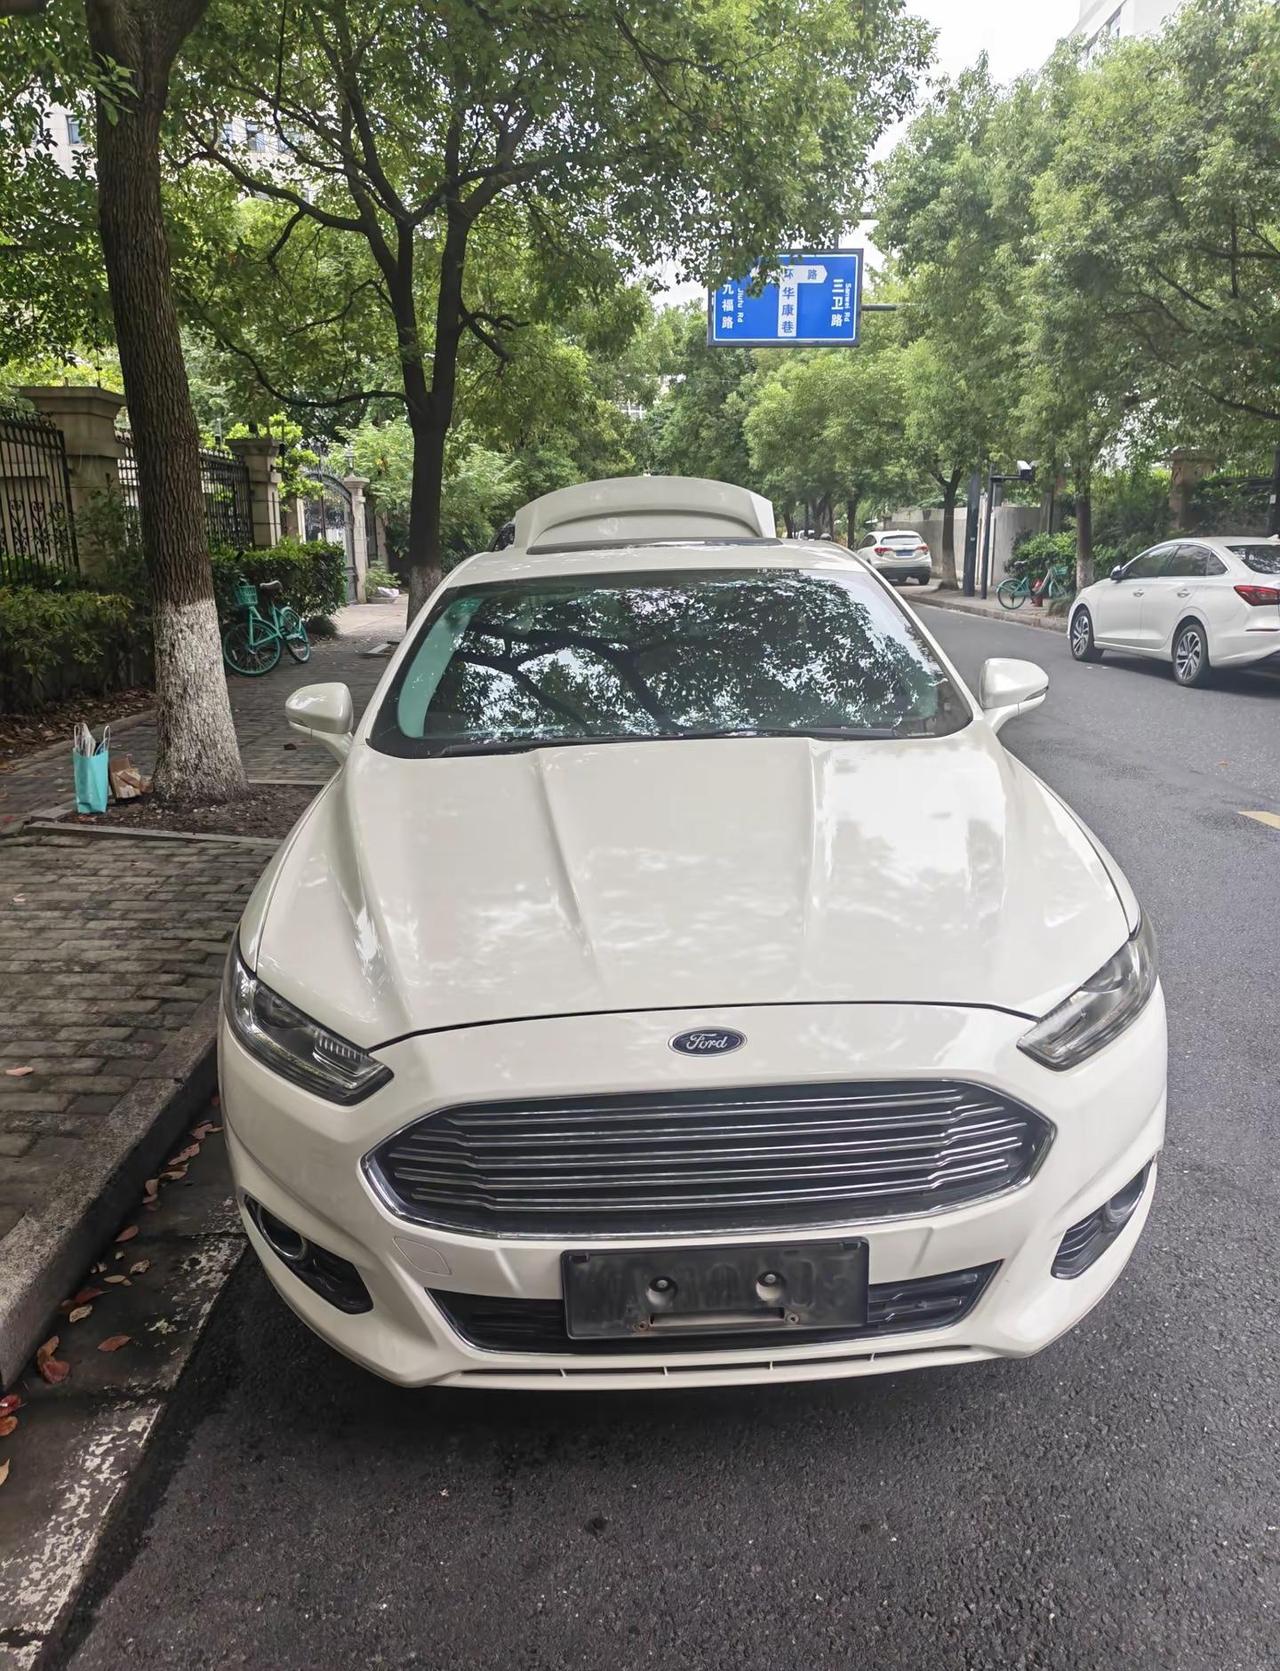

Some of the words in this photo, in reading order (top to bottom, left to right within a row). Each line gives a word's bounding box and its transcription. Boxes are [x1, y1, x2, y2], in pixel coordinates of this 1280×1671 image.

[721, 283, 734, 329] 九福路
[831, 279, 845, 327] 三卫路
[844, 282, 852, 309] Sanwei
[737, 312, 744, 323] Rd
[781, 286, 795, 334] 华康巷
[844, 312, 851, 322] Rd
[686, 1033, 728, 1050] Ford
